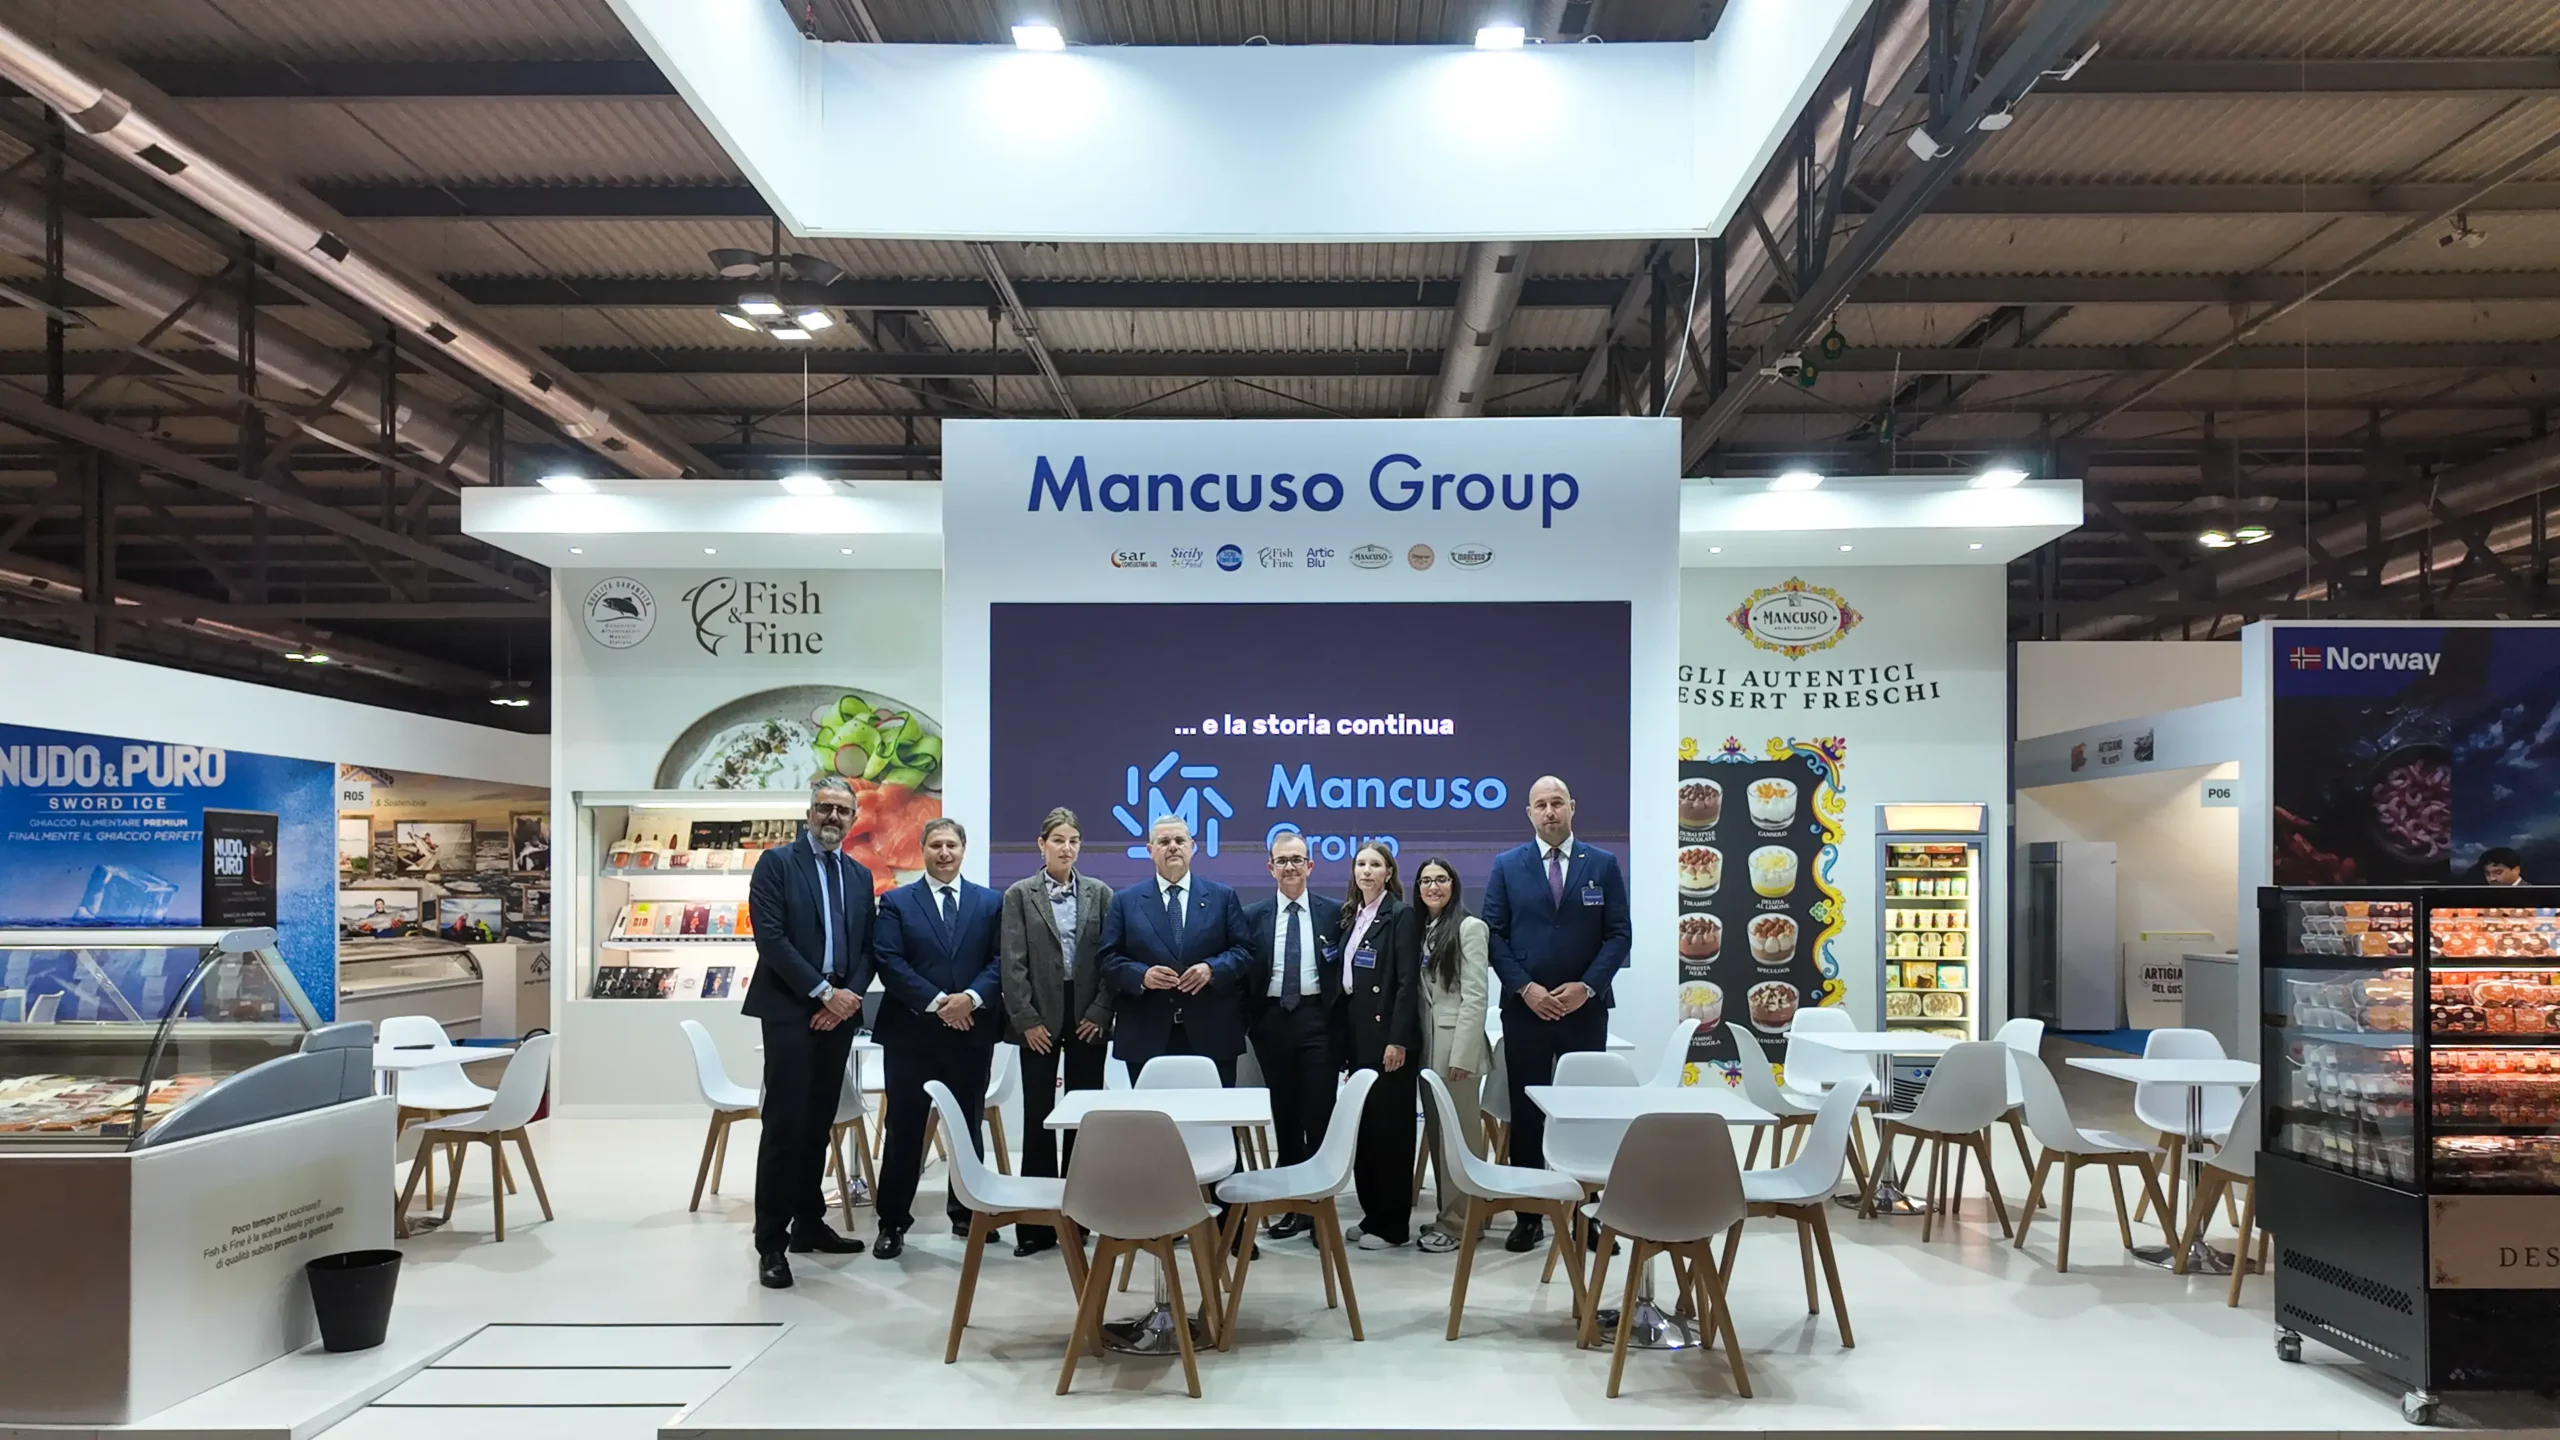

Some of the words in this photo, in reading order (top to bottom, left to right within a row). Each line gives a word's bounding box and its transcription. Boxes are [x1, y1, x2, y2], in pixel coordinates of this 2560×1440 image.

[1027, 456, 1344, 512] Mancuso
[1369, 453, 1580, 529] Group
[1119, 552, 1146, 561] sar
[1171, 547, 1204, 561] Sicily
[1273, 548, 1293, 558] Fish
[1307, 547, 1335, 558] Artic
[1354, 553, 1388, 561] MANCUSO
[1181, 560, 1203, 568] Food
[1273, 559, 1294, 568] Fine
[1307, 558, 1325, 568] Blu
[744, 580, 822, 615] Fish
[728, 606, 743, 624] &
[1763, 610, 1828, 625] MANCUSO
[744, 621, 823, 654] Fine
[2326, 646, 2441, 675] Norway
[1741, 663, 1914, 688] AUTENTICI
[1803, 681, 1942, 709] FRESCHI
[1203, 719, 1219, 736] e
[1223, 714, 1247, 736] la
[1252, 714, 1331, 736] storia
[1337, 714, 1455, 736] continua
[1266, 763, 1508, 810] Mancuso
[2208, 788, 2231, 799] P06
[49, 797, 123, 810] SWORD
[133, 797, 167, 809] ICE
[343, 791, 364, 801] R05
[29, 818, 78, 828] GHIACCIO
[80, 818, 141, 828] ALIMENTARE
[143, 818, 188, 827] PREMIUM
[8, 831, 80, 842] FINALMENTE
[83, 831, 94, 841] IL
[96, 831, 151, 841] GHIACCIO
[214, 857, 243, 875] PURO
[2152, 984, 2165, 993] DEL
[232, 1223, 251, 1235] Poco
[252, 1215, 275, 1229] tempo
[277, 1211, 288, 1222] per
[203, 1246, 220, 1259] Fish
[221, 1244, 227, 1253] &
[229, 1239, 245, 1250] Fine
[253, 1233, 260, 1242] la
[304, 1216, 315, 1227] per
[216, 1259, 223, 1269] di
[251, 1243, 273, 1257] subito
[274, 1235, 297, 1250] pronto
[299, 1231, 307, 1240] da
[2499, 1246, 2560, 1268] DES
